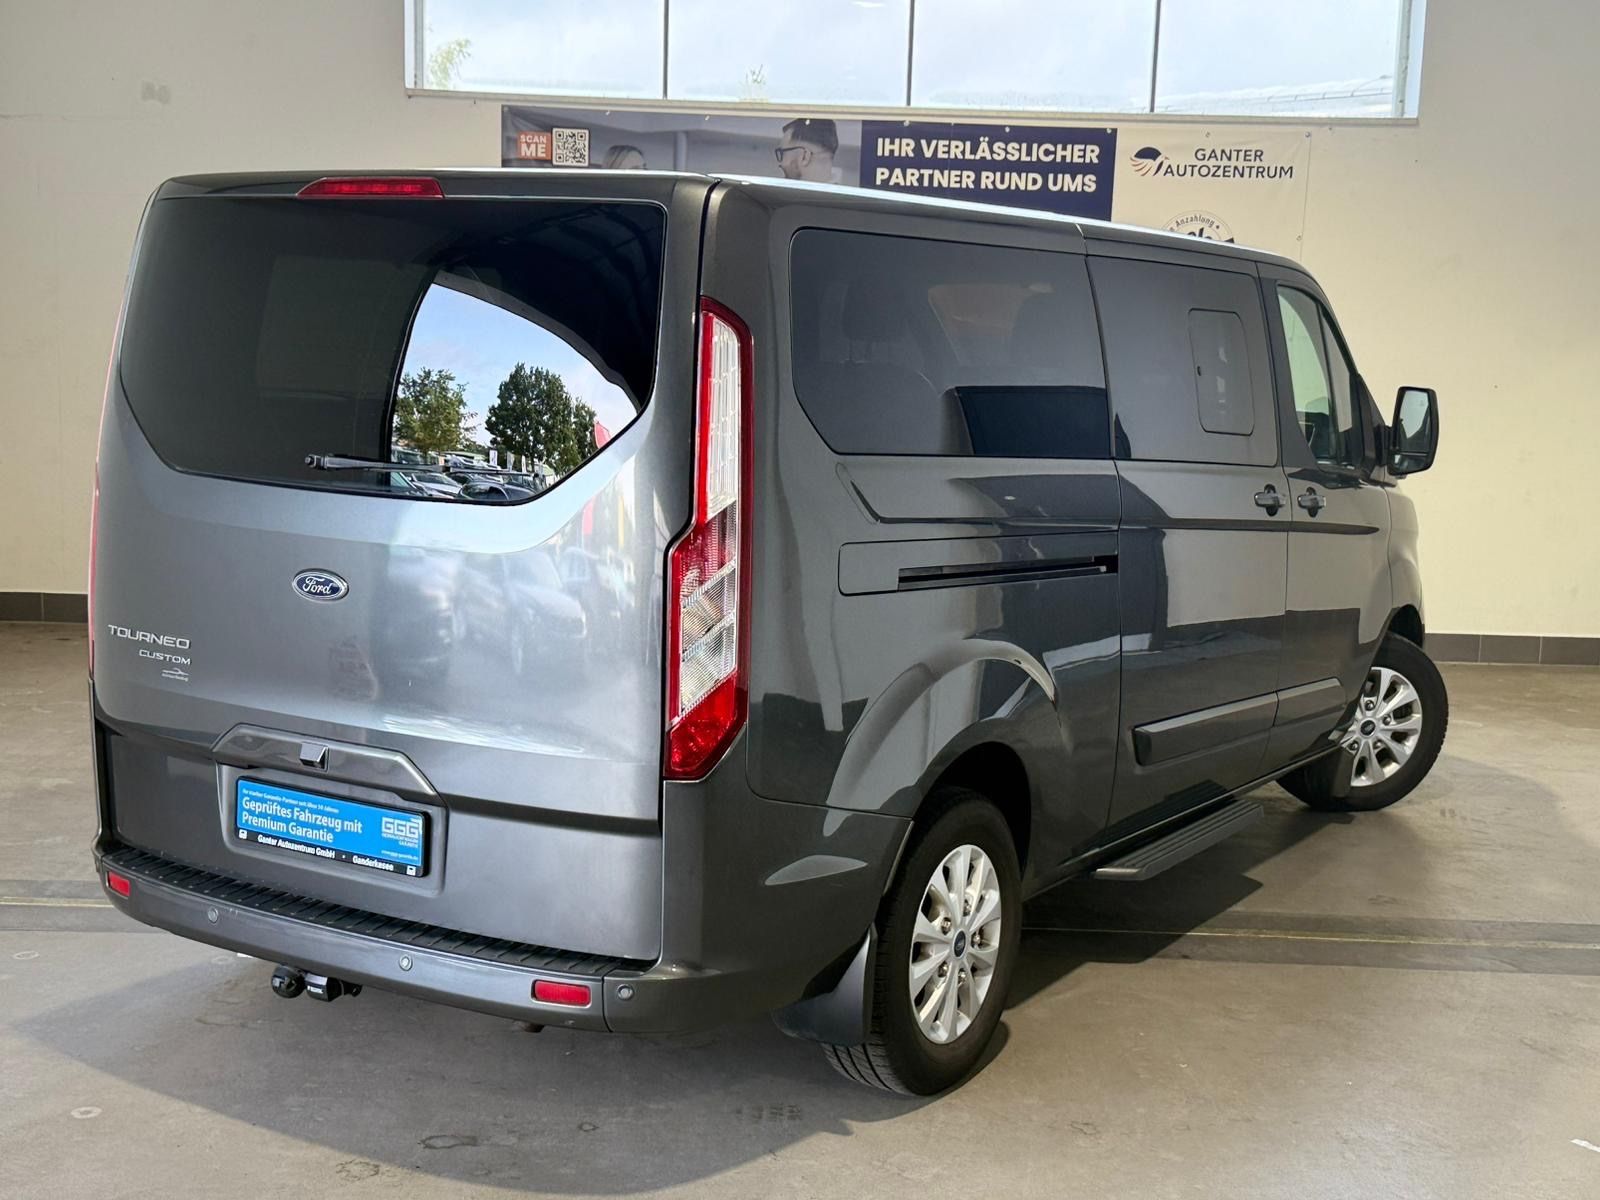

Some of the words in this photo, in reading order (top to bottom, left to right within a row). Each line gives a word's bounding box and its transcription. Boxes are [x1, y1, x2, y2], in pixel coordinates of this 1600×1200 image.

[519, 134, 547, 144] SCAN
[521, 143, 547, 157] ME
[876, 137, 914, 158] IHR
[919, 137, 1101, 164] VERLÄSSLICHER
[1194, 147, 1265, 163] GANTER
[875, 168, 975, 190] PARTNER
[980, 171, 1043, 191] RUND
[1048, 174, 1098, 193] UMS
[1163, 163, 1295, 180] AUTOZENTRUM
[303, 576, 333, 594] Ford
[107, 624, 191, 649] TOURNEO
[139, 649, 191, 665] CUSTOM
[242, 796, 292, 819] Geprüftes
[293, 806, 342, 833] Fahrzeug
[343, 820, 362, 834] mit
[242, 812, 287, 833] Premium
[288, 822, 333, 843] Garantie
[257, 834, 277, 845] Ganter
[277, 837, 315, 855] Autozentrum
[315, 846, 335, 859] GmbH
[352, 855, 394, 871] Ganderkesee
